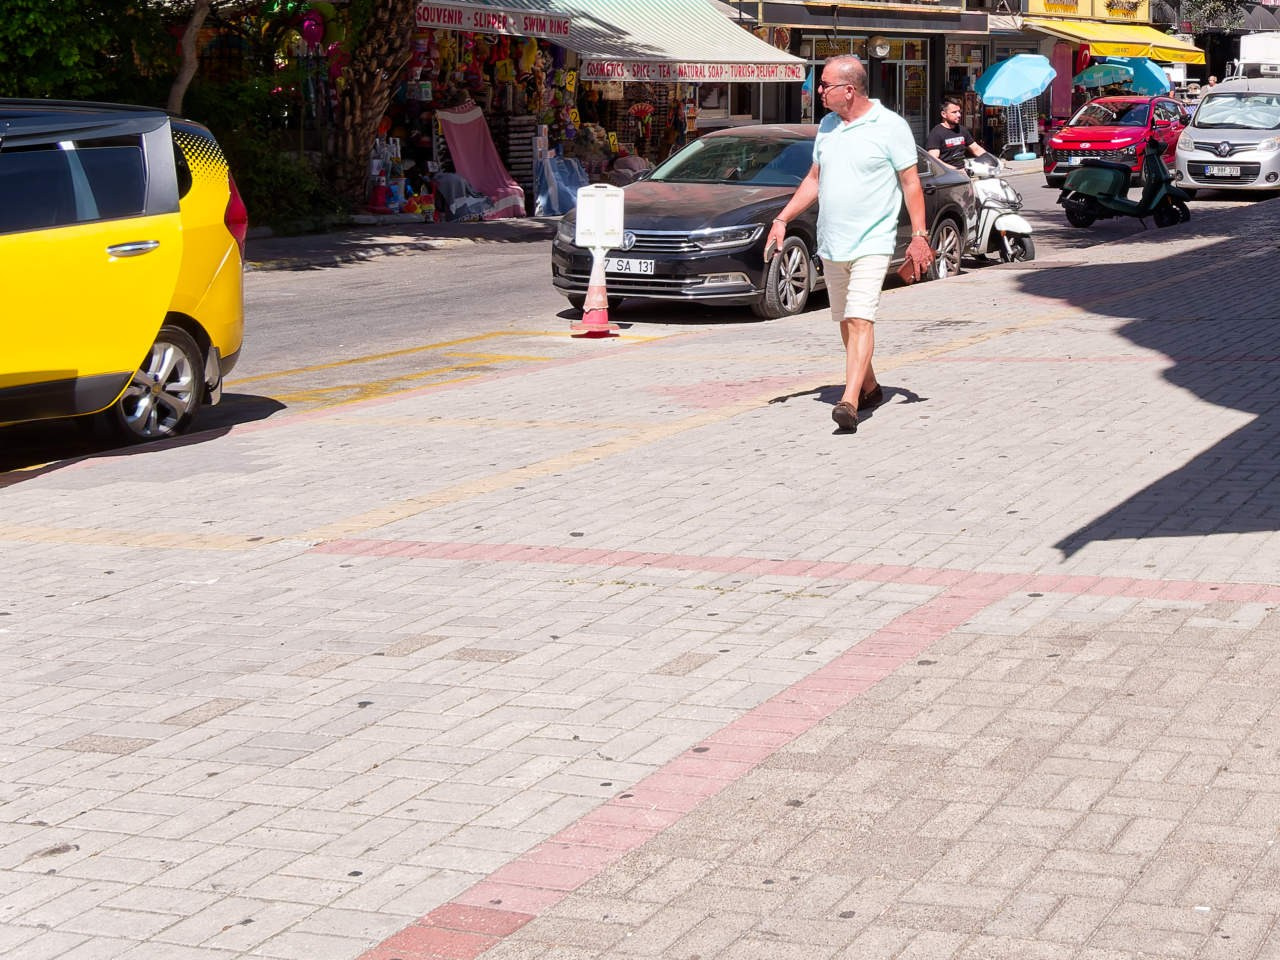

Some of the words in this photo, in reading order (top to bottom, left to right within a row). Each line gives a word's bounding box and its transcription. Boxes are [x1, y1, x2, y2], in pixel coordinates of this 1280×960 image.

[416, 6, 464, 26] SOUVENIR
[473, 11, 509, 31] SLIPPER
[523, 16, 546, 33] SWIM
[549, 19, 570, 36] RING
[587, 62, 625, 78] COSMETICS
[632, 63, 651, 78] SPICE
[659, 64, 672, 78] TEA
[678, 64, 706, 79] NATURAL
[708, 65, 724, 79] SOAP
[731, 65, 755, 79] TURKISH
[756, 65, 779, 79] DELIGHT
[616, 259, 632, 271] SA
[638, 261, 654, 272] 131
